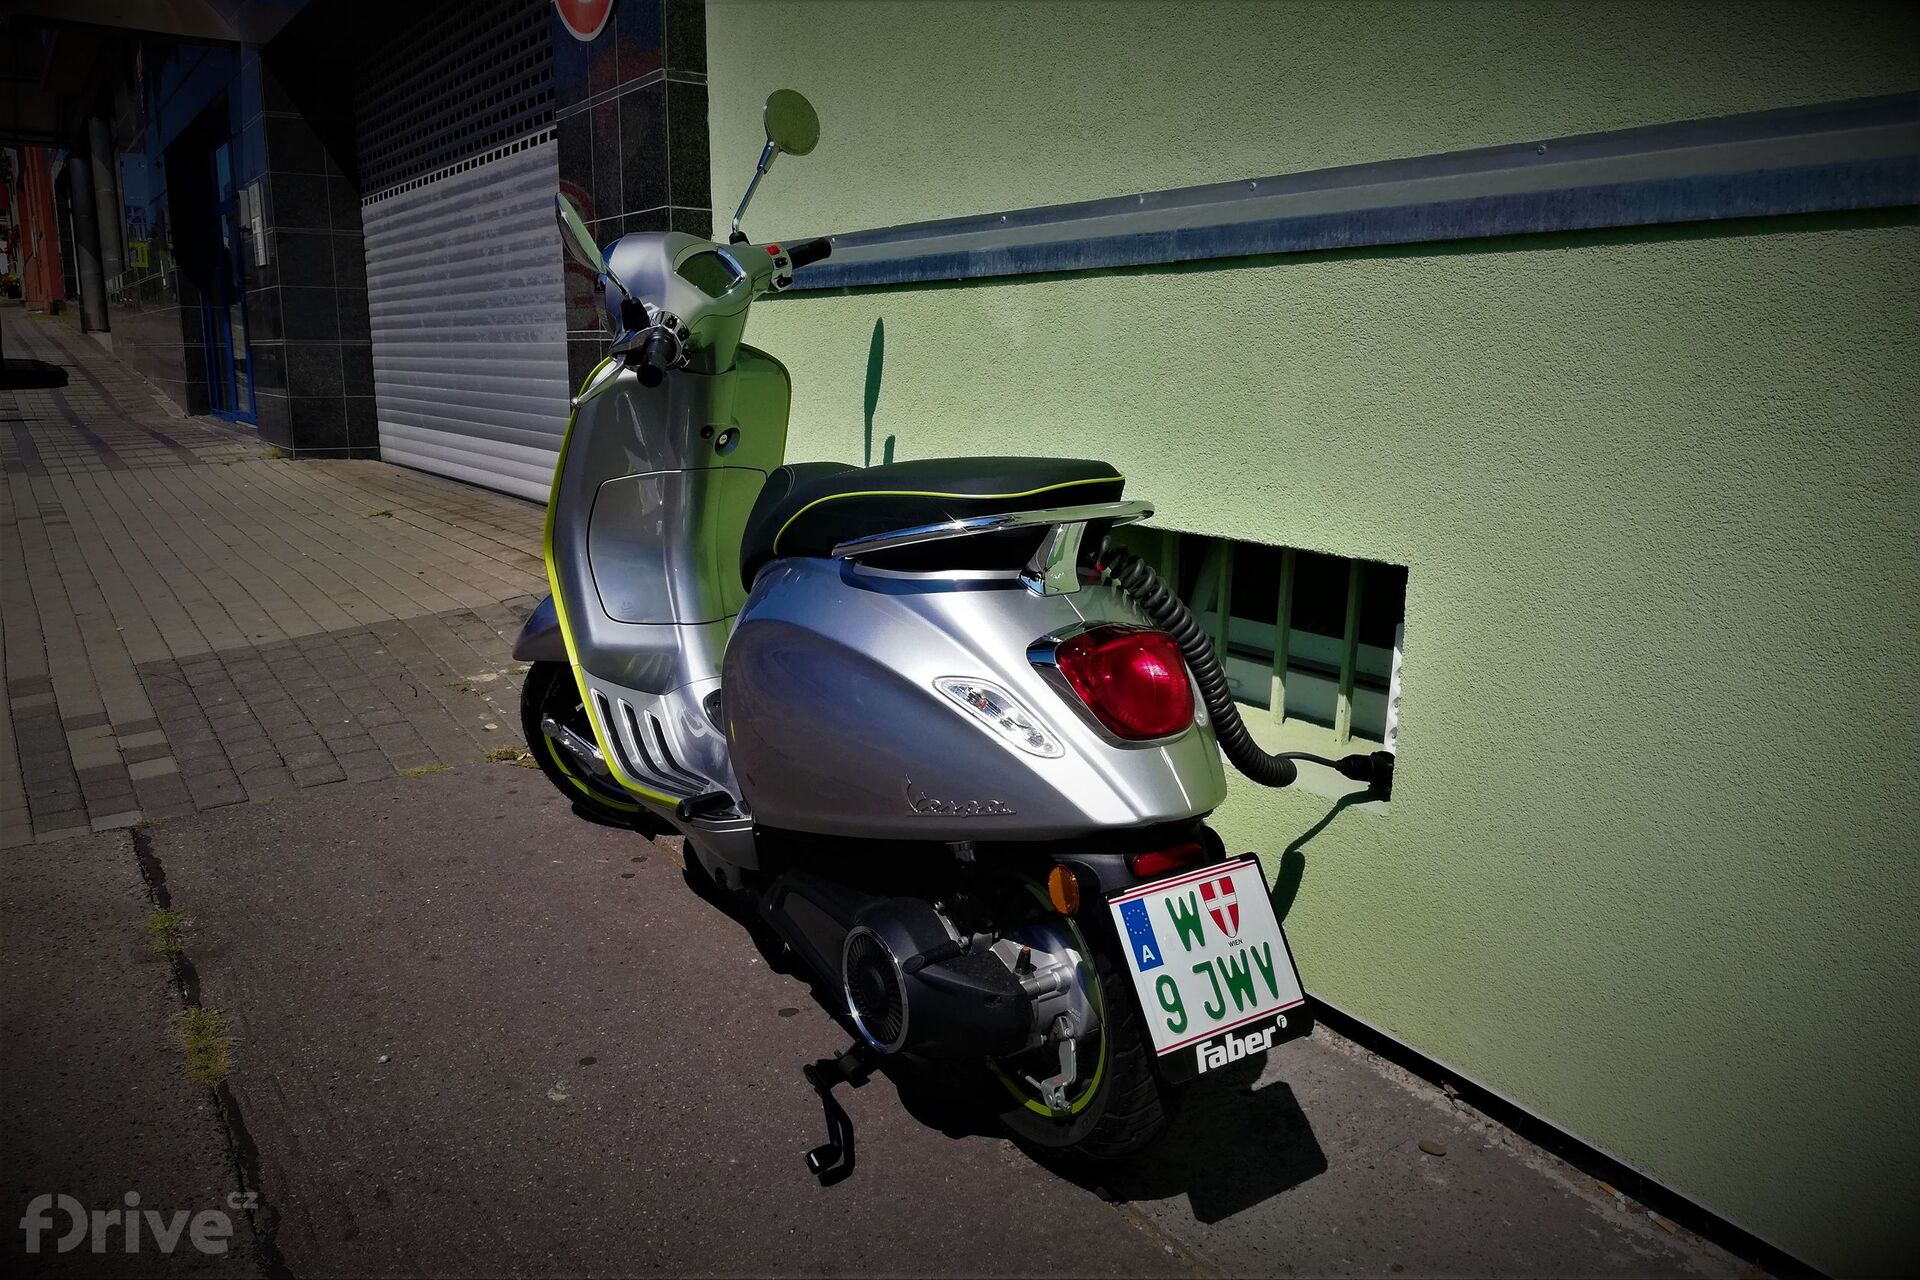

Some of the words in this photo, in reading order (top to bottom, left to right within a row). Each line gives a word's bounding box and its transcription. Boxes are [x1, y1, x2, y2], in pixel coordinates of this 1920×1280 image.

[905, 774, 1017, 817] Vespa
[1165, 891, 1205, 951] W
[1227, 938, 1243, 947] WIEN
[1142, 945, 1155, 963] A
[1156, 974, 1187, 1033] 9
[1192, 942, 1279, 1019] JWV
[1196, 1025, 1276, 1074] Faber
